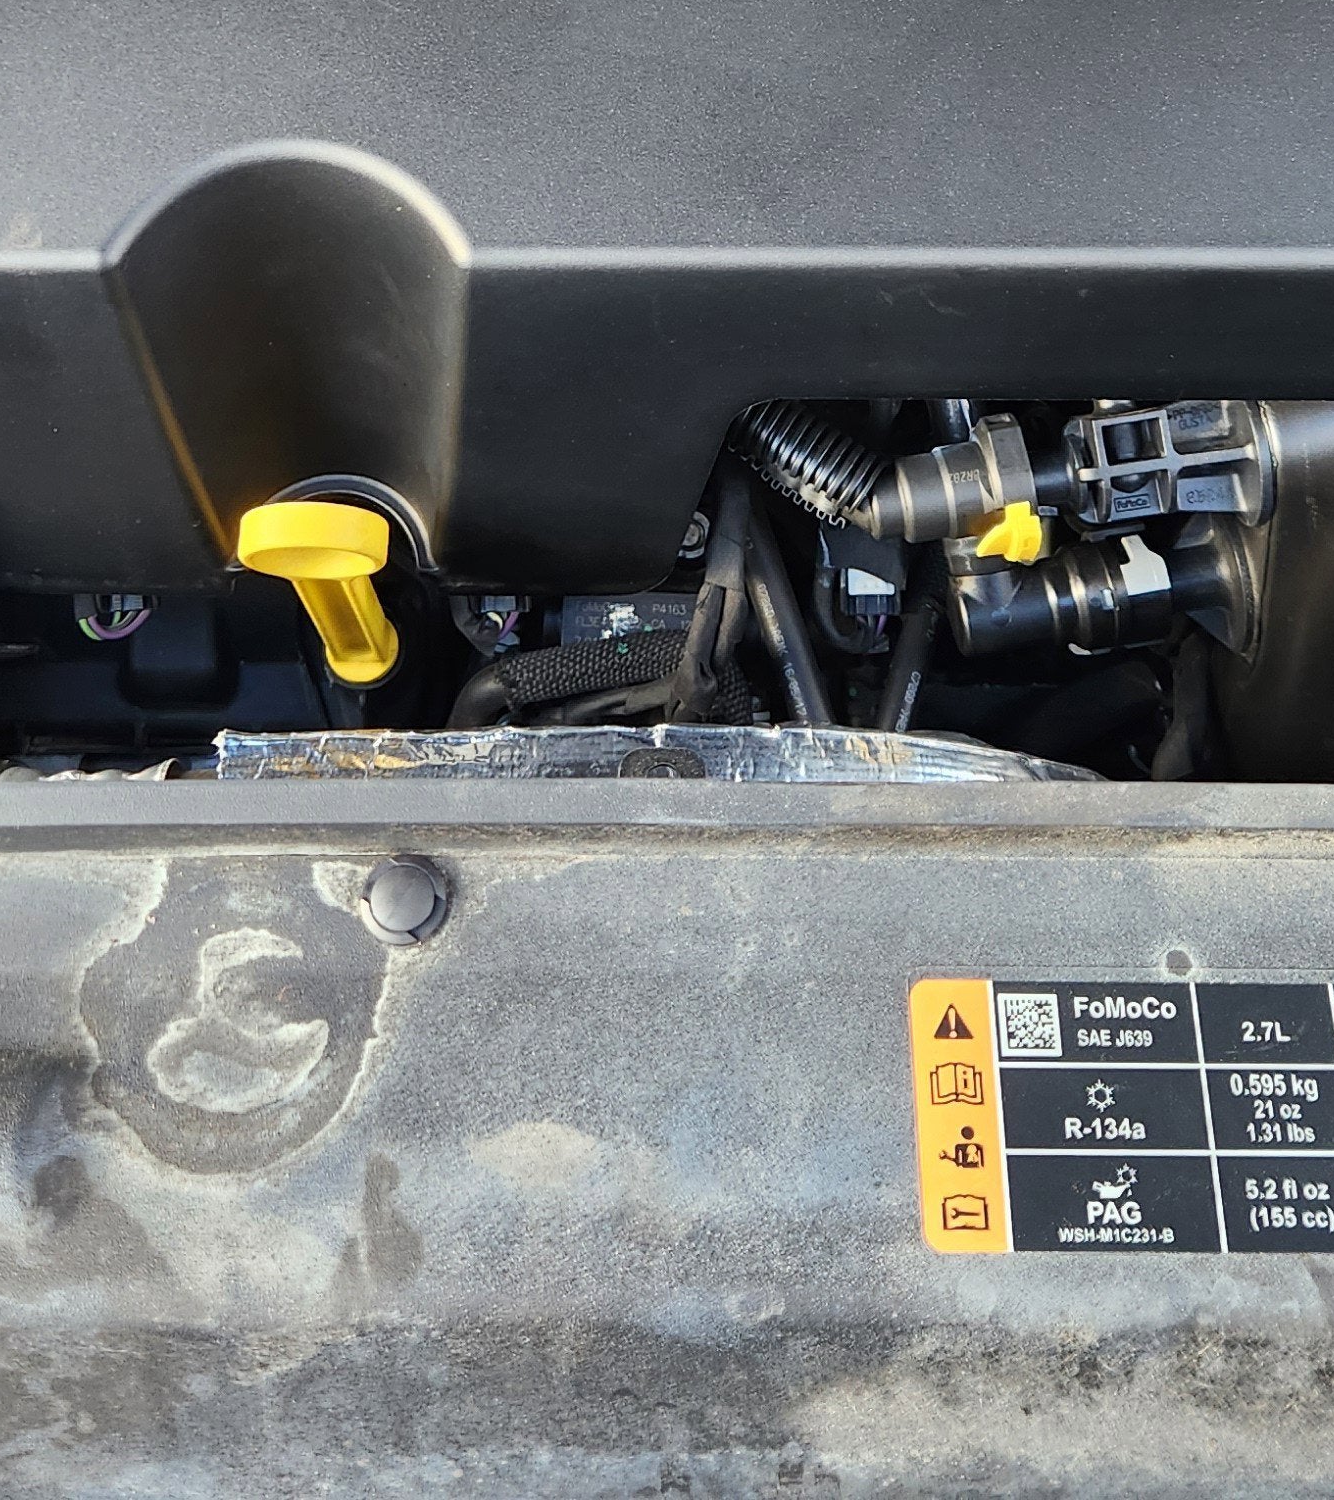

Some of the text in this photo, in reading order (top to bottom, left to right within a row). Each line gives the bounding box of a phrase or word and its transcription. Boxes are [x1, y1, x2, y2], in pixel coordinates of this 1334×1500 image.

[1073, 996, 1177, 1019] FoMoCo
[1077, 1029, 1153, 1047] SAE J639
[1241, 1021, 1291, 1042] 2.7L
[1229, 1073, 1319, 1102] 0.595 kg
[1253, 1099, 1302, 1120] 21 oz
[1064, 1117, 1147, 1140] R-134a
[1246, 1122, 1316, 1143] 1.31 lbs
[1245, 1178, 1331, 1201] 5.2 fl oz
[1086, 1201, 1142, 1225] PAG
[1249, 1205, 1298, 1232] (155
[1058, 1227, 1175, 1244] WSH-M1C231-B
